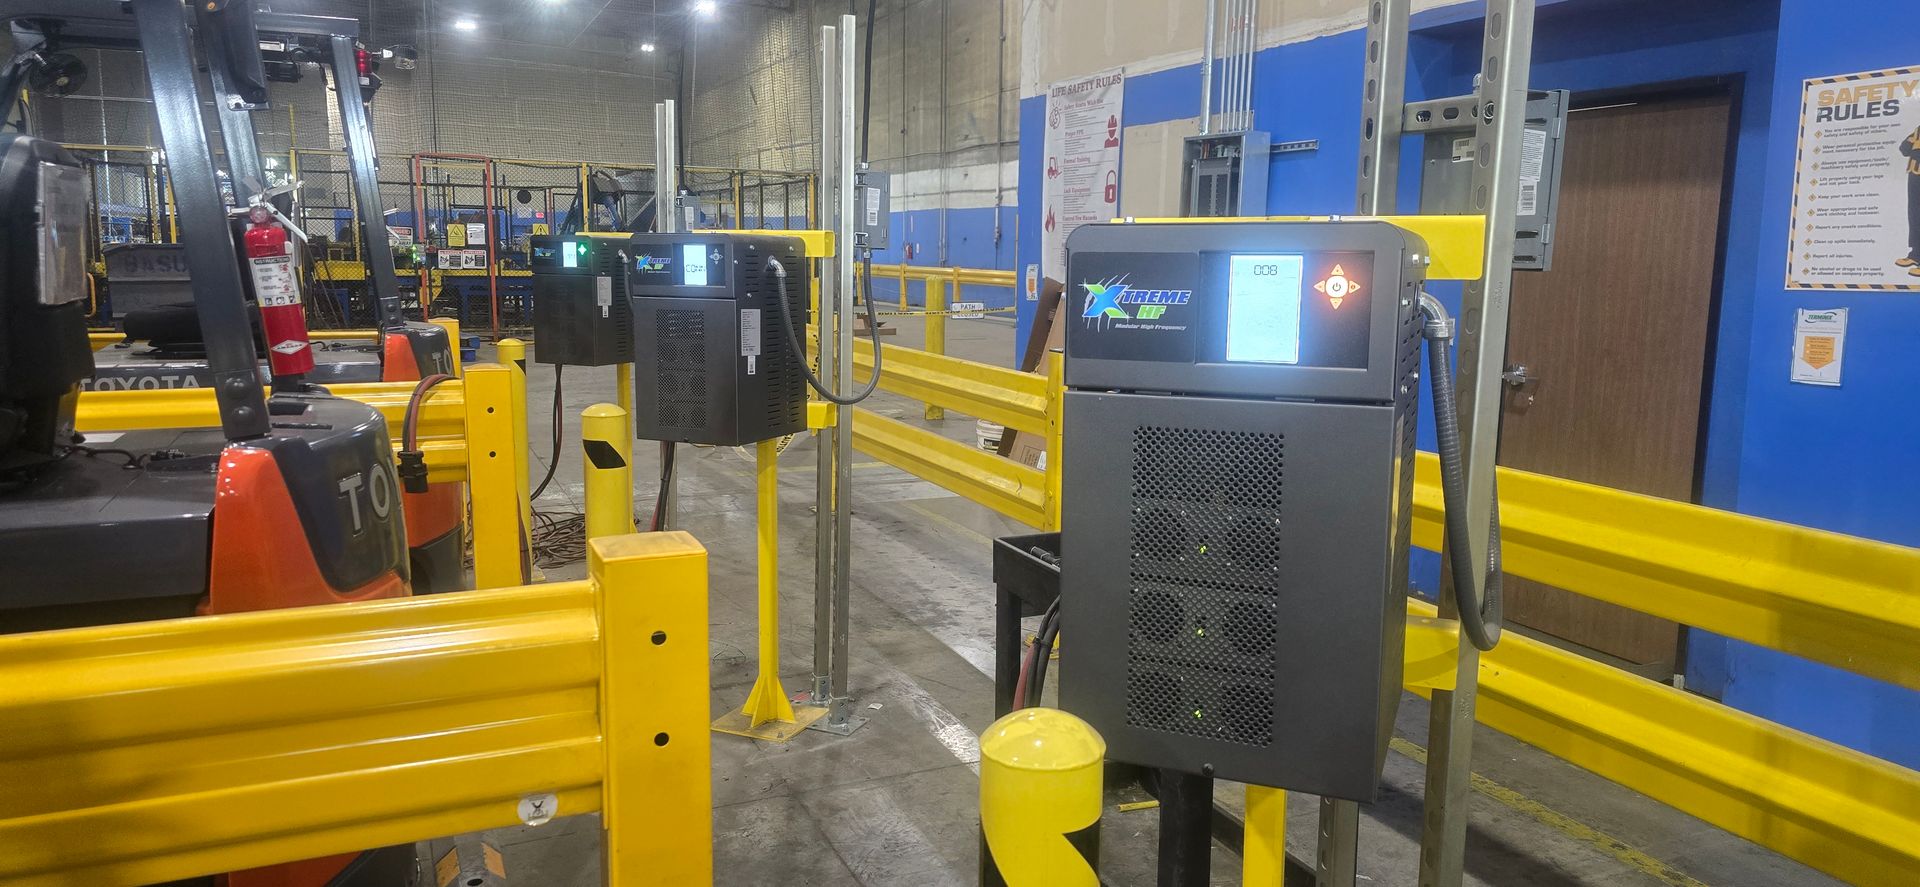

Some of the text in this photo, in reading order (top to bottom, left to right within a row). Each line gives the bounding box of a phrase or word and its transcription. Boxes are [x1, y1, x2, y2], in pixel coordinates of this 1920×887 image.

[1052, 74, 1121, 98] LIFE SAFETY RULES
[1818, 80, 1918, 106] SAFETY
[1816, 99, 1899, 122] RULES
[1254, 265, 1277, 275] 008
[1082, 284, 1192, 318] XTREME
[1136, 305, 1167, 320] HF
[80, 375, 200, 391] TOYOTA
[338, 459, 401, 536] TO
